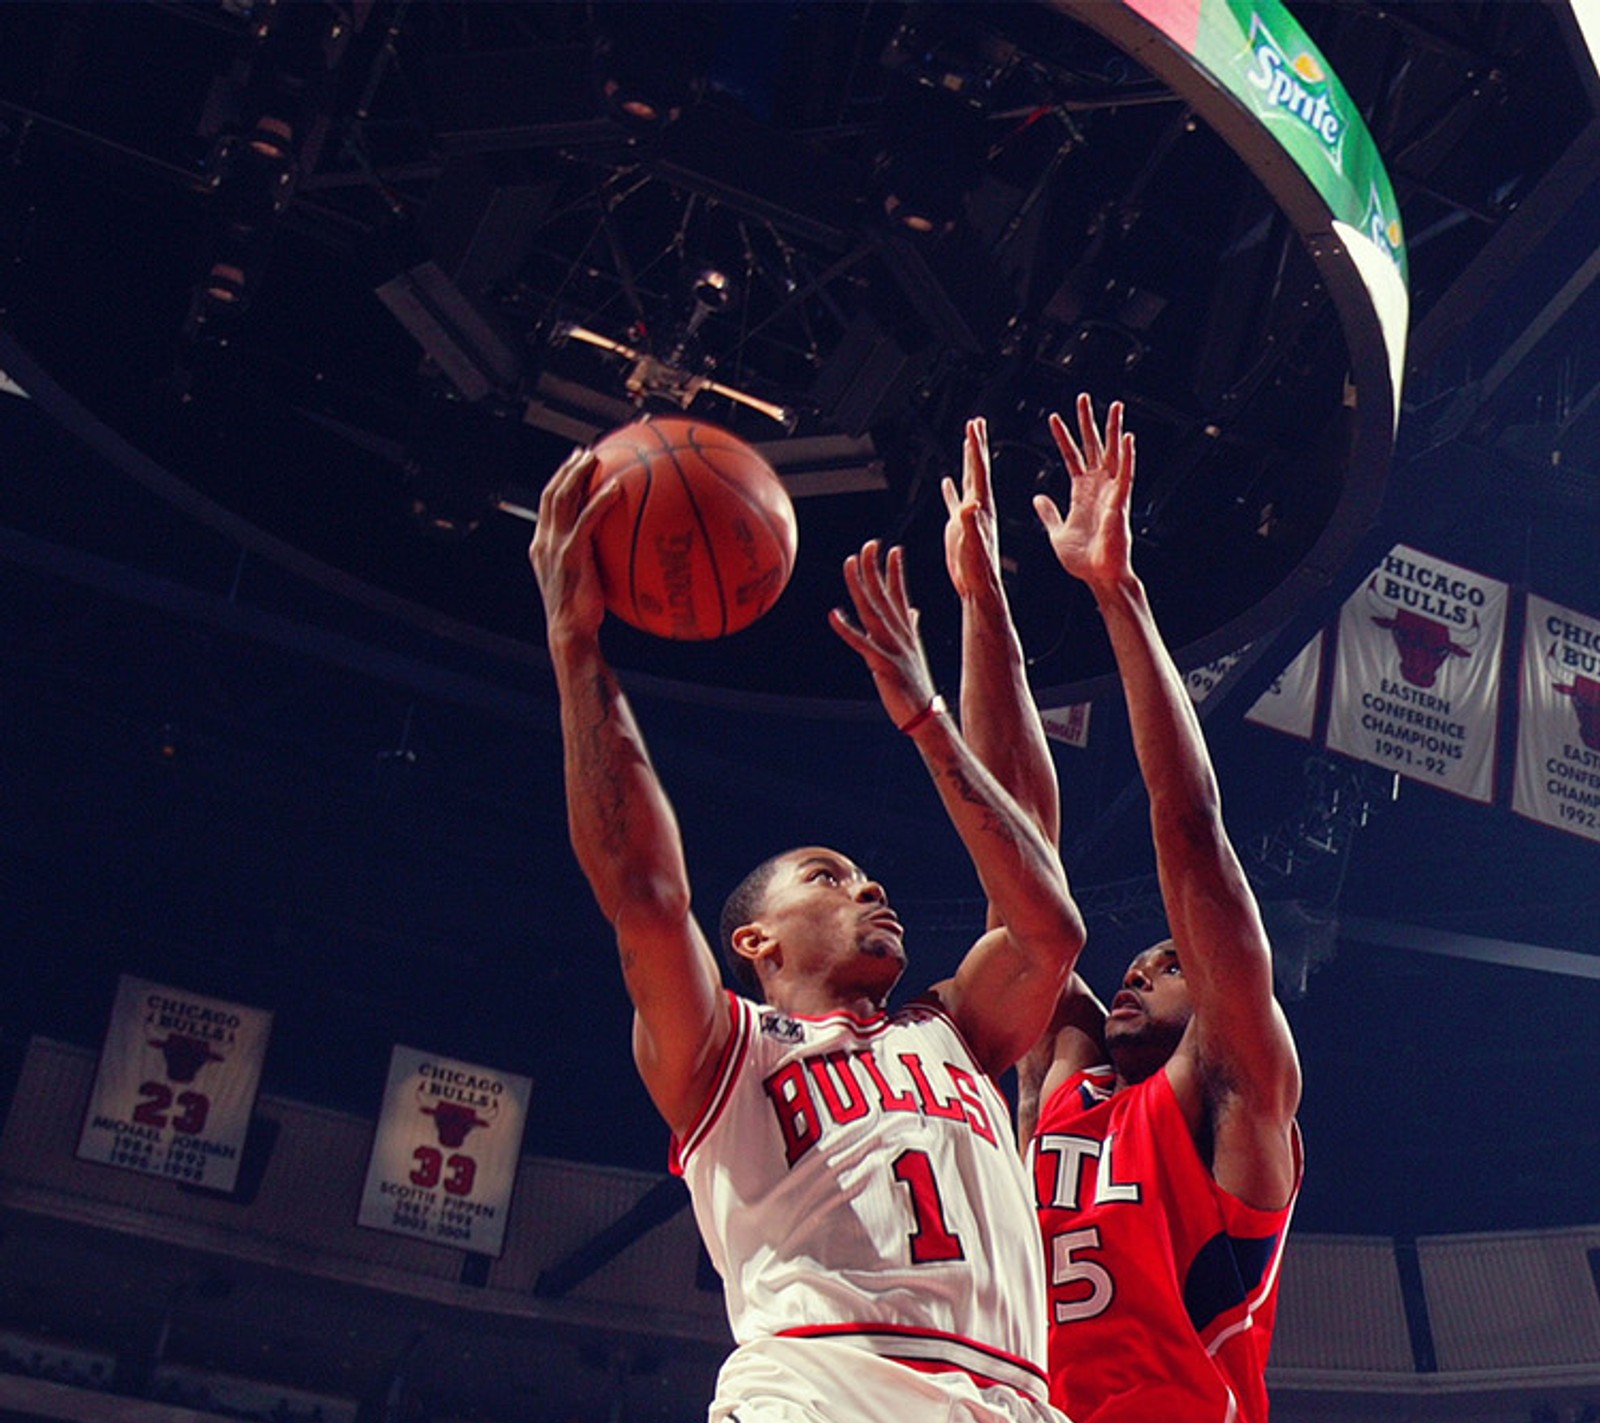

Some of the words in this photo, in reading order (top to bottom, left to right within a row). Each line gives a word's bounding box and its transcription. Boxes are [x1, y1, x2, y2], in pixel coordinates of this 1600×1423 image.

[1249, 46, 1339, 143] Sprite
[1383, 578, 1467, 625] BULLS
[1384, 556, 1485, 607] HICAGO
[1563, 646, 1600, 676] BU
[1362, 693, 1466, 740] CONFERENCE
[1381, 679, 1450, 715] EASTERN
[1361, 714, 1463, 760] CHAMPIONS
[1374, 739, 1445, 775] 1991-92
[147, 995, 240, 1029] CHICAGO
[160, 1014, 226, 1041] BULLS
[419, 1063, 503, 1095] CHICAGO
[430, 1083, 488, 1108] BULLS
[133, 1080, 210, 1135] 23
[763, 1049, 998, 1170] BULLS
[92, 1116, 161, 1142] MICHAEL
[172, 1136, 236, 1159] JORDAN
[409, 1145, 477, 1197] 33
[380, 1182, 436, 1204] SCOTTIE
[443, 1197, 495, 1218] PIPPEN
[891, 1148, 966, 1264] 1
[1048, 1225, 1116, 1325] 5
